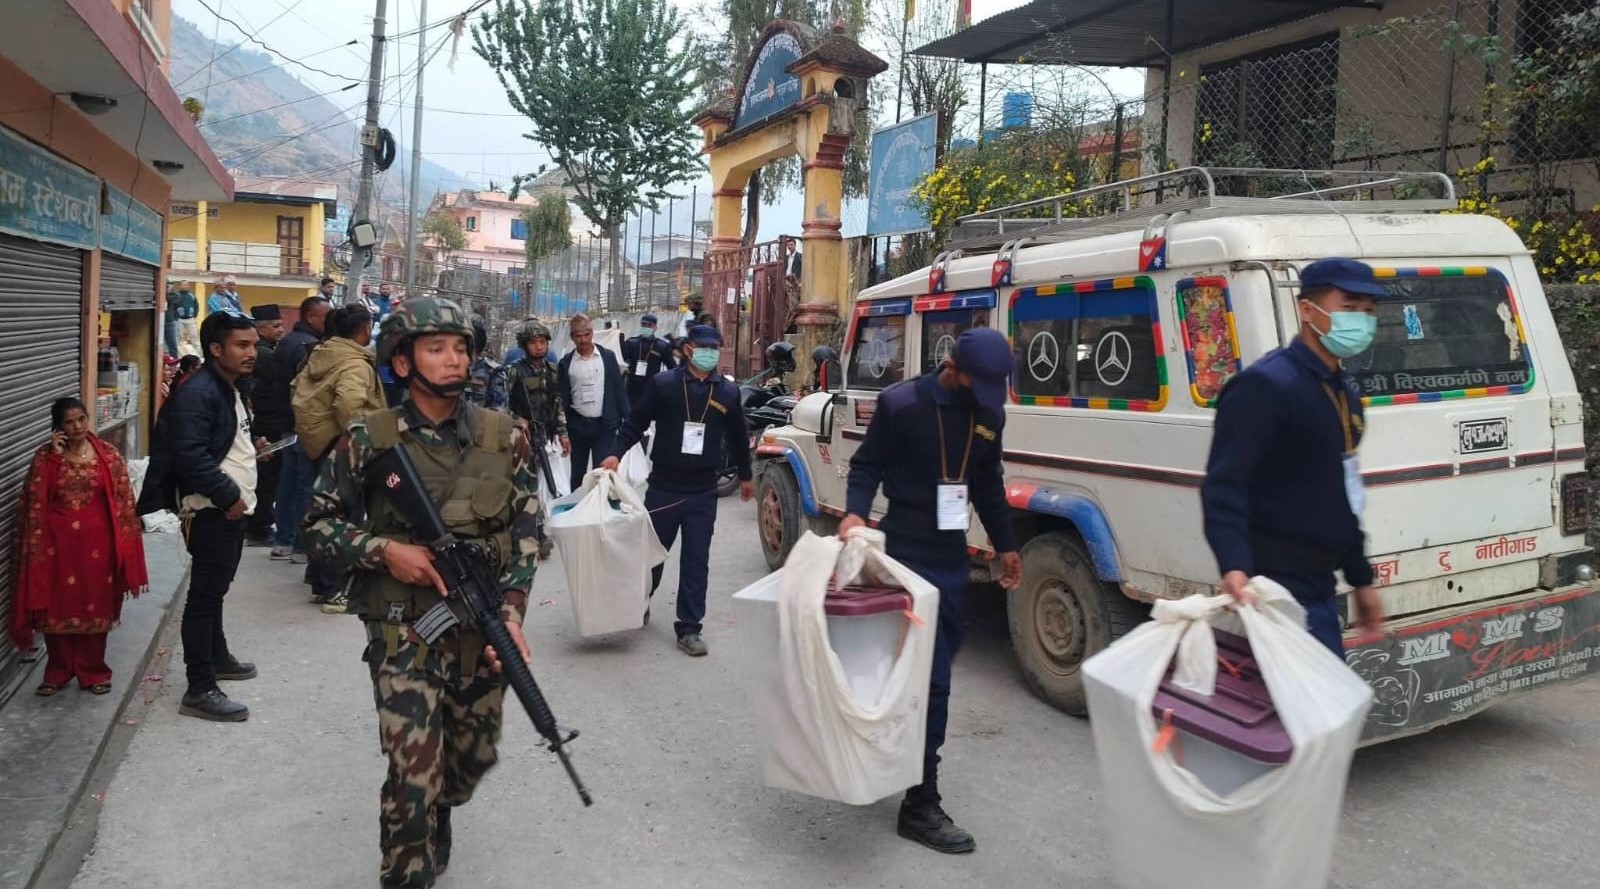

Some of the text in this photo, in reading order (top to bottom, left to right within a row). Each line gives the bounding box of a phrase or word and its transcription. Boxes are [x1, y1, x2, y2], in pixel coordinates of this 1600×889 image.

[31, 176, 98, 230] स्टेशनरी
[1363, 373, 1388, 393] श्री
[1475, 535, 1538, 561] नातीगाड
